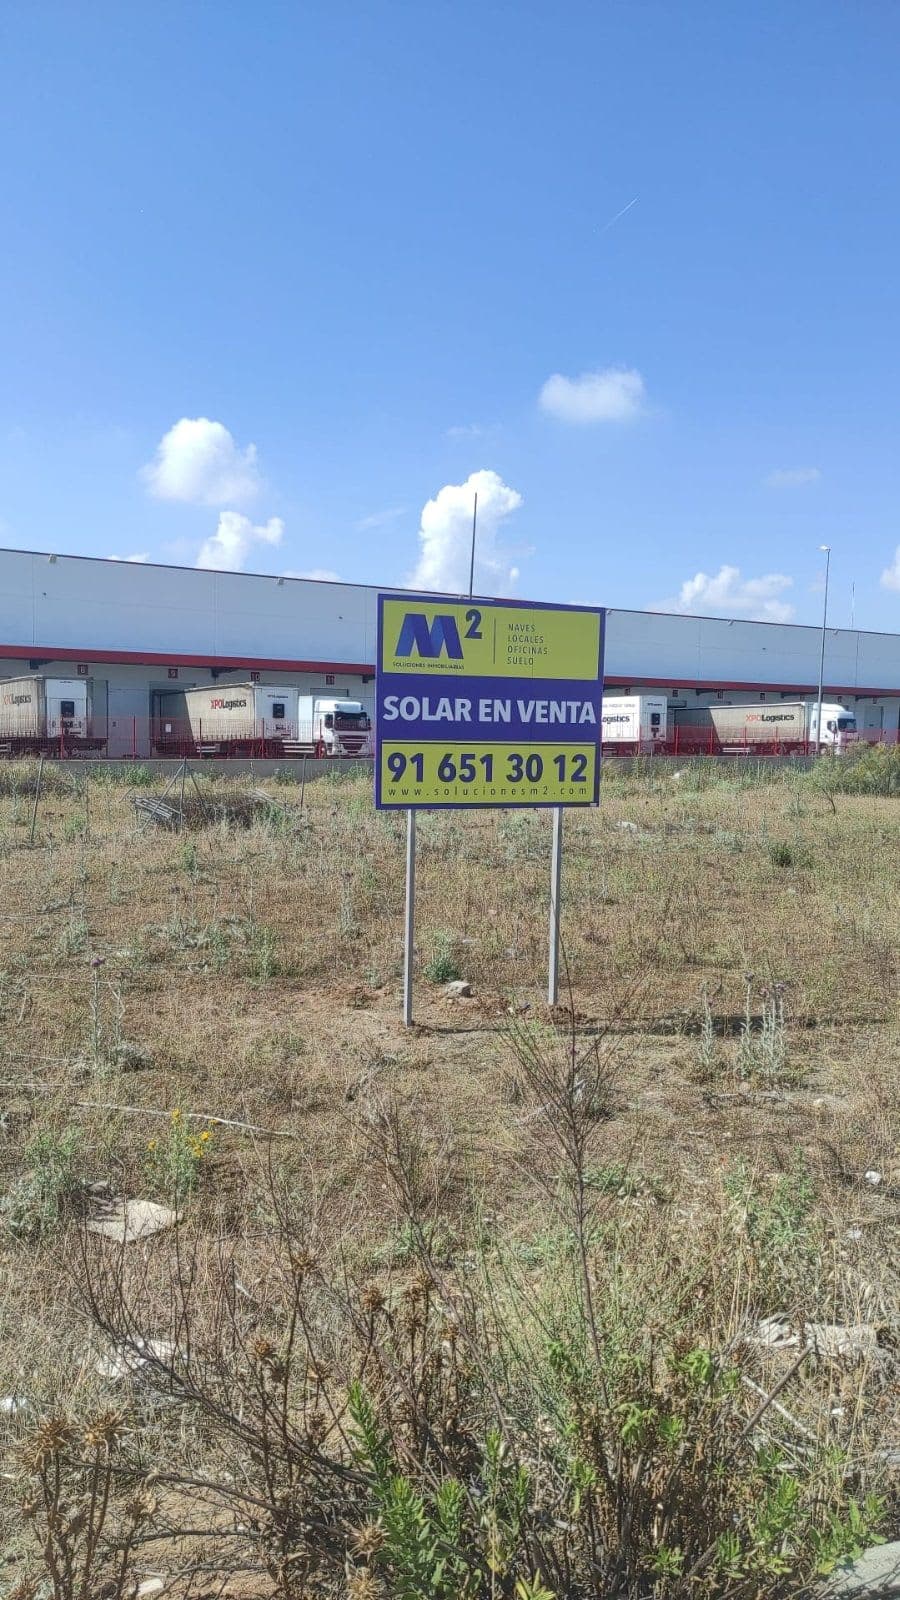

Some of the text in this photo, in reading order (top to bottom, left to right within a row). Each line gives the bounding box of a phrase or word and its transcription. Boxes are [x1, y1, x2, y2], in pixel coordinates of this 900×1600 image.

[507, 623, 536, 633] NAVES
[507, 634, 545, 644] LOCALES
[507, 645, 549, 655] OFICINAS
[506, 656, 534, 666] SUELO
[383, 695, 597, 724] SOLAR EN VENTA
[601, 714, 631, 725] ogistics
[387, 752, 588, 783] 91 651 30 12
[388, 785, 587, 797] www.solucionesm2.com
